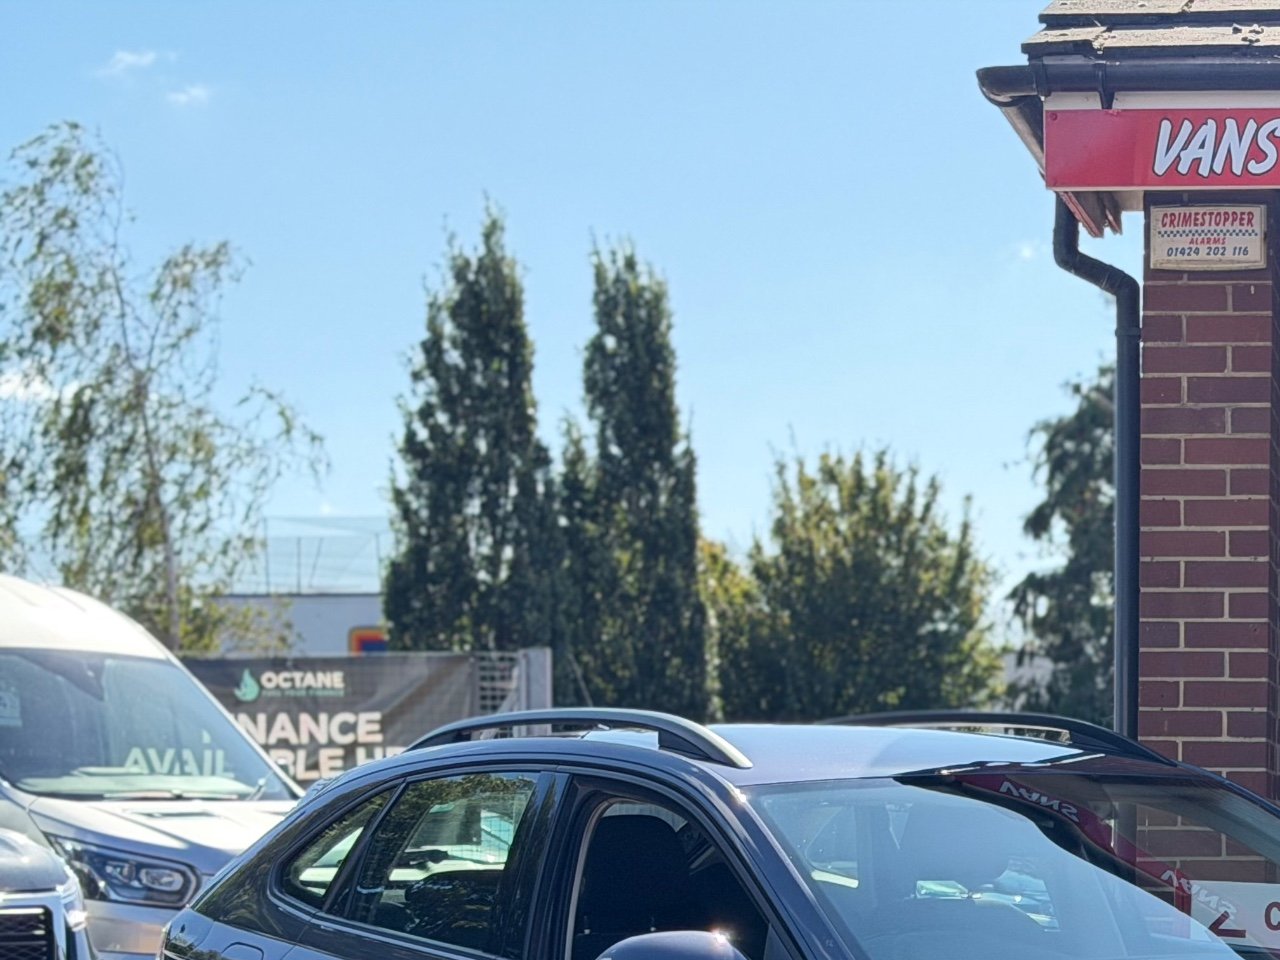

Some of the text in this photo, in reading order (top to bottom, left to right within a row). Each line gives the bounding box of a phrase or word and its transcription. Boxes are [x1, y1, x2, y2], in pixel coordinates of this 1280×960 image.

[1161, 211, 1255, 228] CRIMESTOPPER
[1189, 237, 1226, 246] ALARMS
[1167, 246, 1249, 257] 01424 202 116
[261, 671, 344, 689] OCTANE
[231, 711, 384, 746] NANCE
